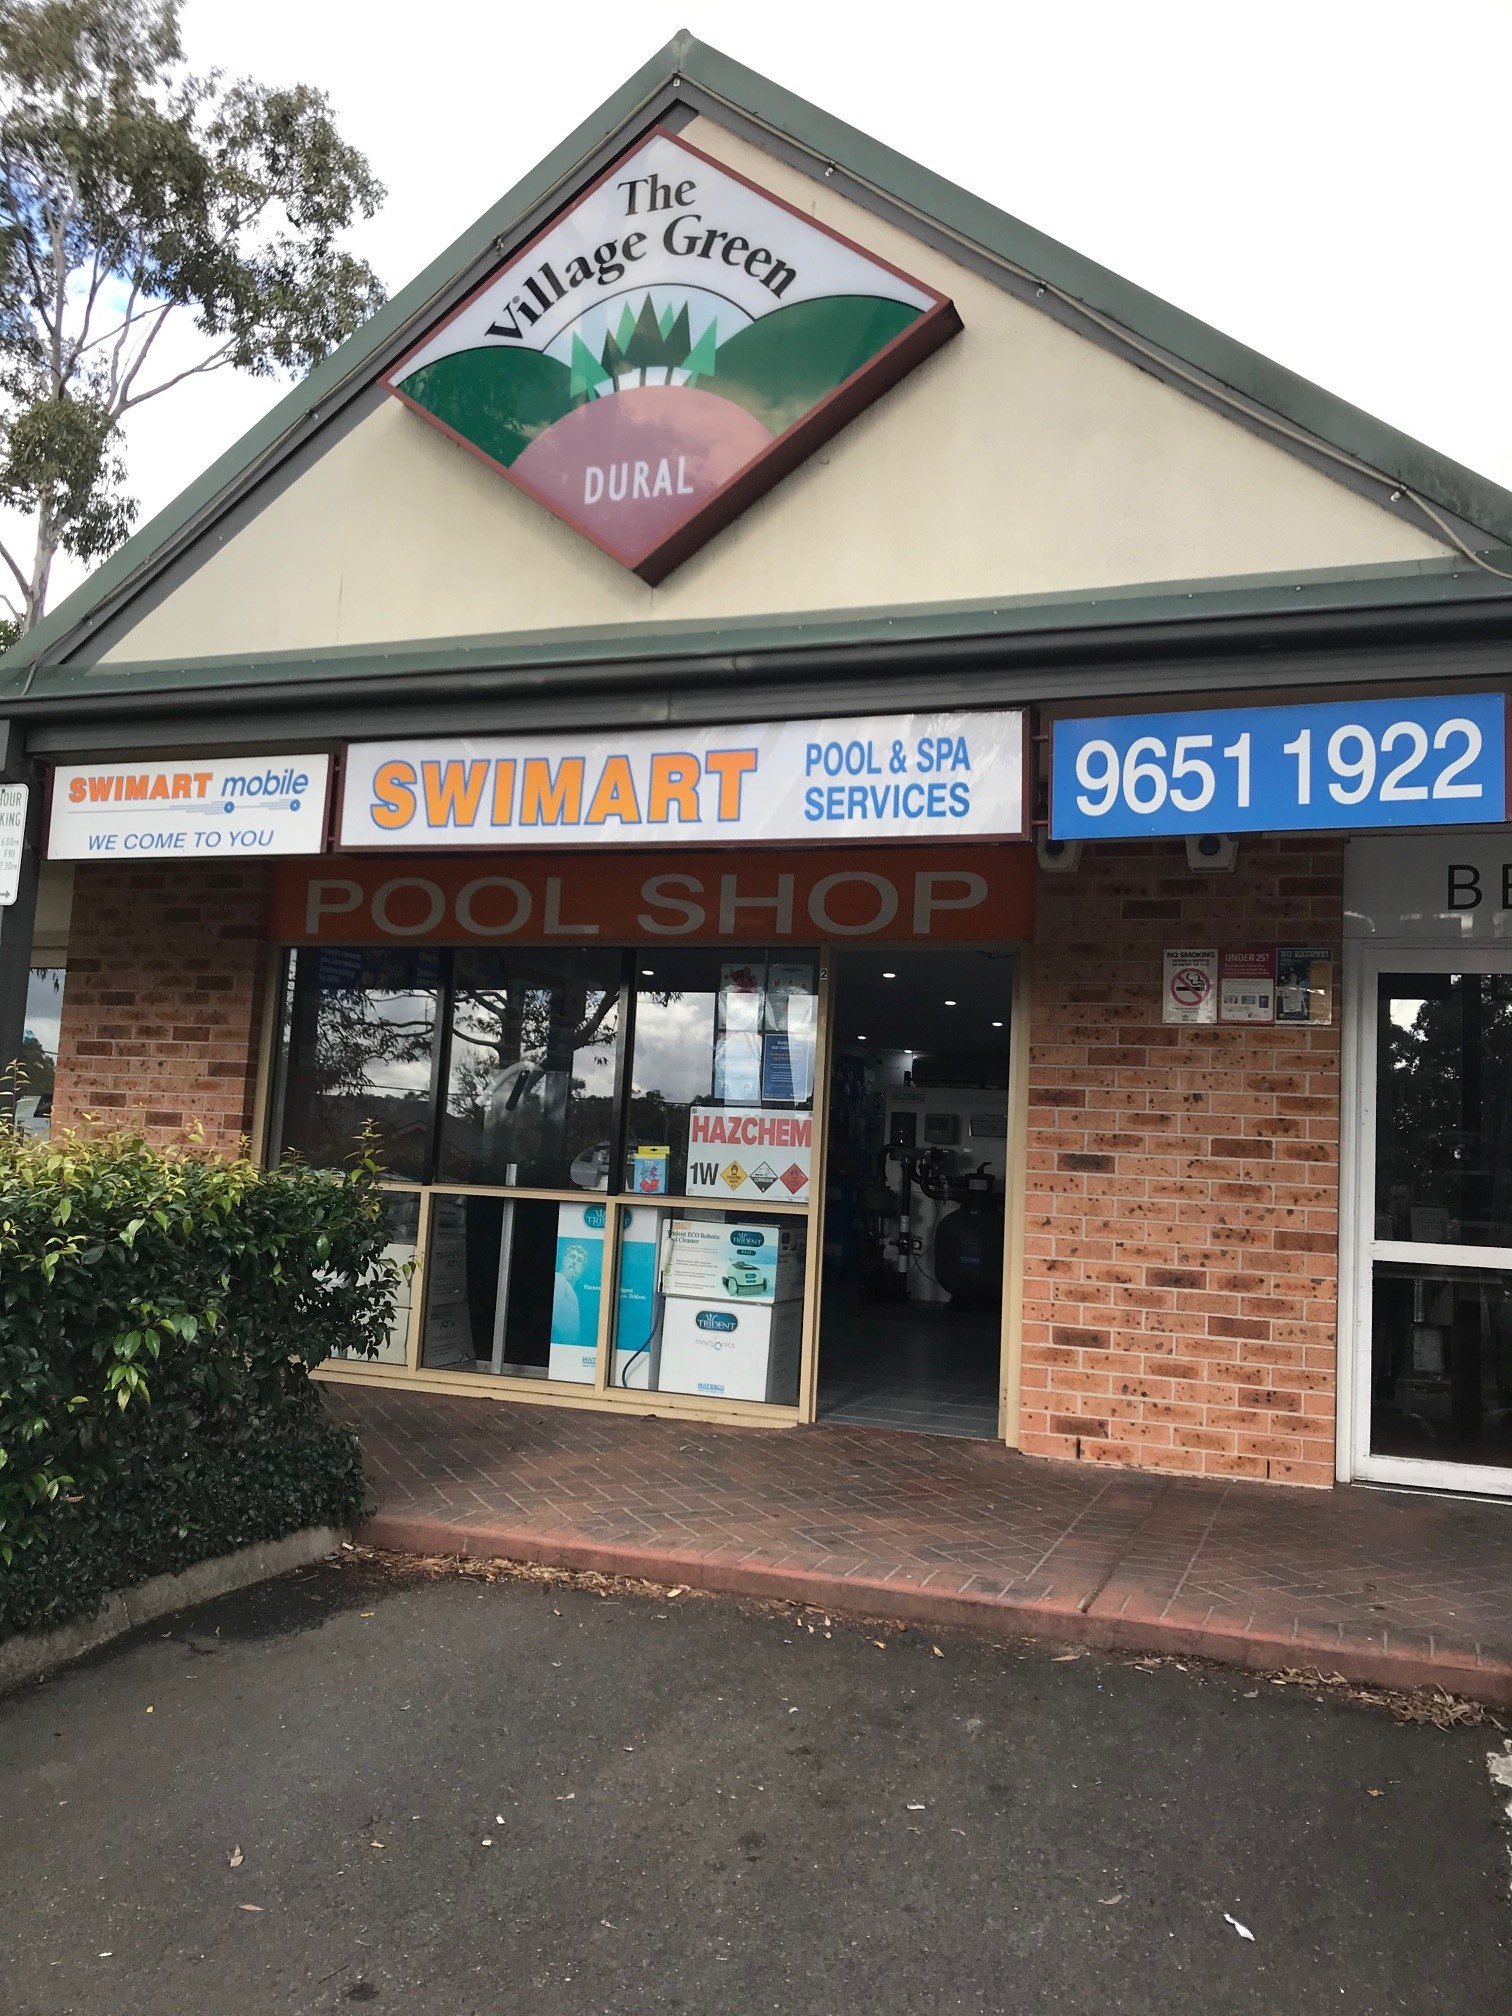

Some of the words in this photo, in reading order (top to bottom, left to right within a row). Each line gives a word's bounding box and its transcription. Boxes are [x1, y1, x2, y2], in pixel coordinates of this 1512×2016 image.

[617, 173, 697, 216] The
[484, 230, 648, 340] Village
[662, 213, 798, 300] Green
[583, 456, 694, 505] DURAL
[804, 739, 882, 777] POOL
[891, 739, 909, 774] &
[916, 736, 972, 773] SPA
[1075, 732, 1251, 817] 9651
[1283, 718, 1483, 806] 1922
[68, 773, 214, 803] SWIMART
[221, 768, 310, 797] mobile
[370, 747, 758, 830] SWIMART
[804, 782, 971, 822] SERVICES
[4, 849, 15, 858] FRI
[88, 834, 117, 850] WE
[123, 832, 188, 849] COME
[195, 831, 223, 847] TO
[228, 830, 275, 847] YOU
[304, 876, 600, 935] POOL
[636, 871, 989, 935] SHOP
[821, 969, 827, 979] 2
[1225, 953, 1255, 962] UNDER
[1255, 953, 1270, 962] 25?
[691, 1115, 812, 1148] HAZCHEM
[689, 1162, 720, 1186] 1W
[678, 1237, 700, 1245] Cleaner
[701, 1232, 721, 1240] Robotic
[732, 1235, 761, 1245] TRIDENT
[697, 1318, 736, 1331] TRIDENT
